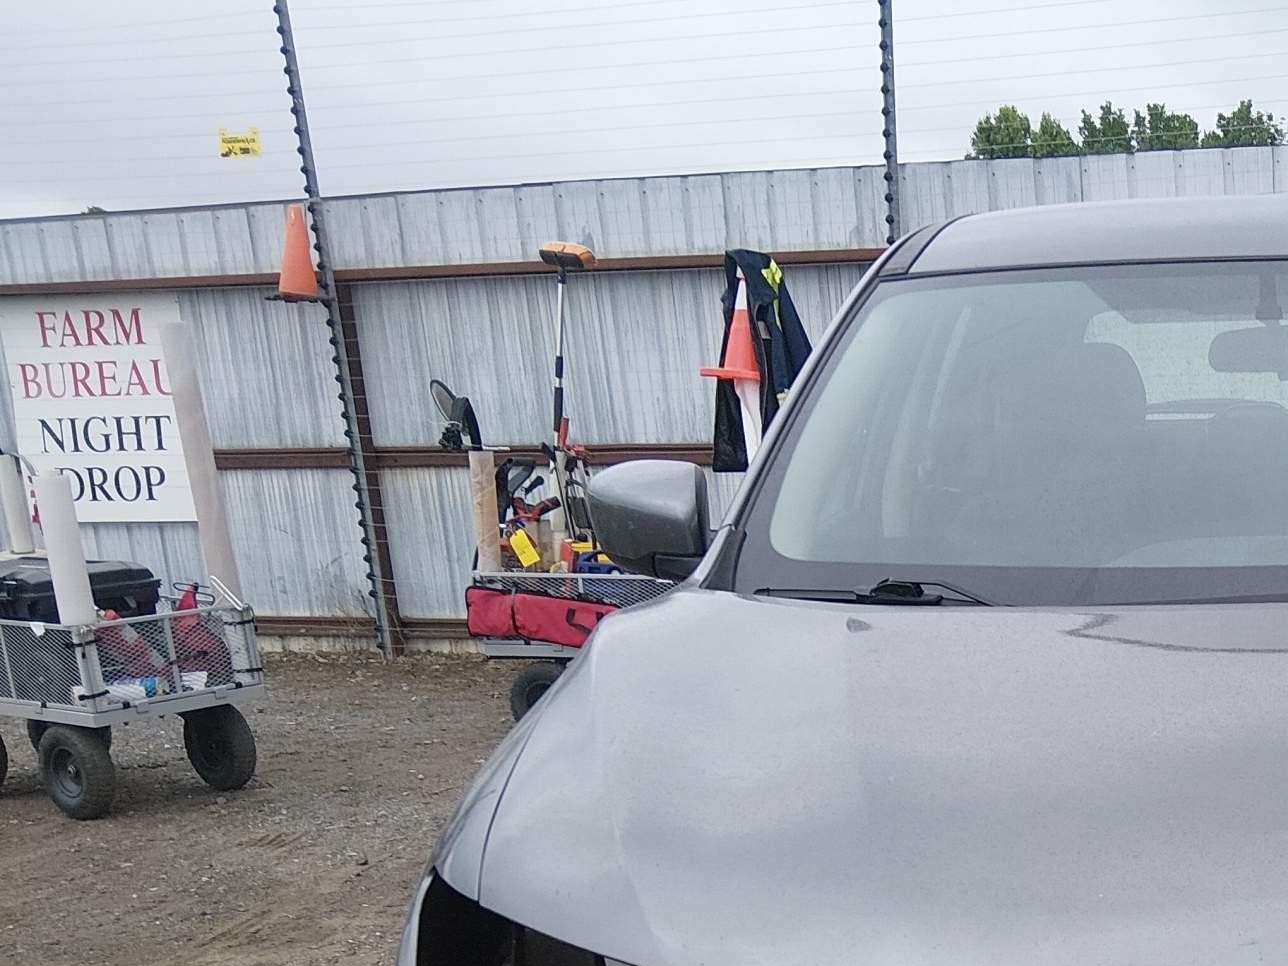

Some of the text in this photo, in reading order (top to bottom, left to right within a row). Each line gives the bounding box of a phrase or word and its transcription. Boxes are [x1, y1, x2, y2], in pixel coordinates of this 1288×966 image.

[35, 307, 147, 347] FARM
[18, 359, 173, 399] BUREAU
[38, 415, 172, 454] NIGHT
[55, 465, 167, 502] DROP
